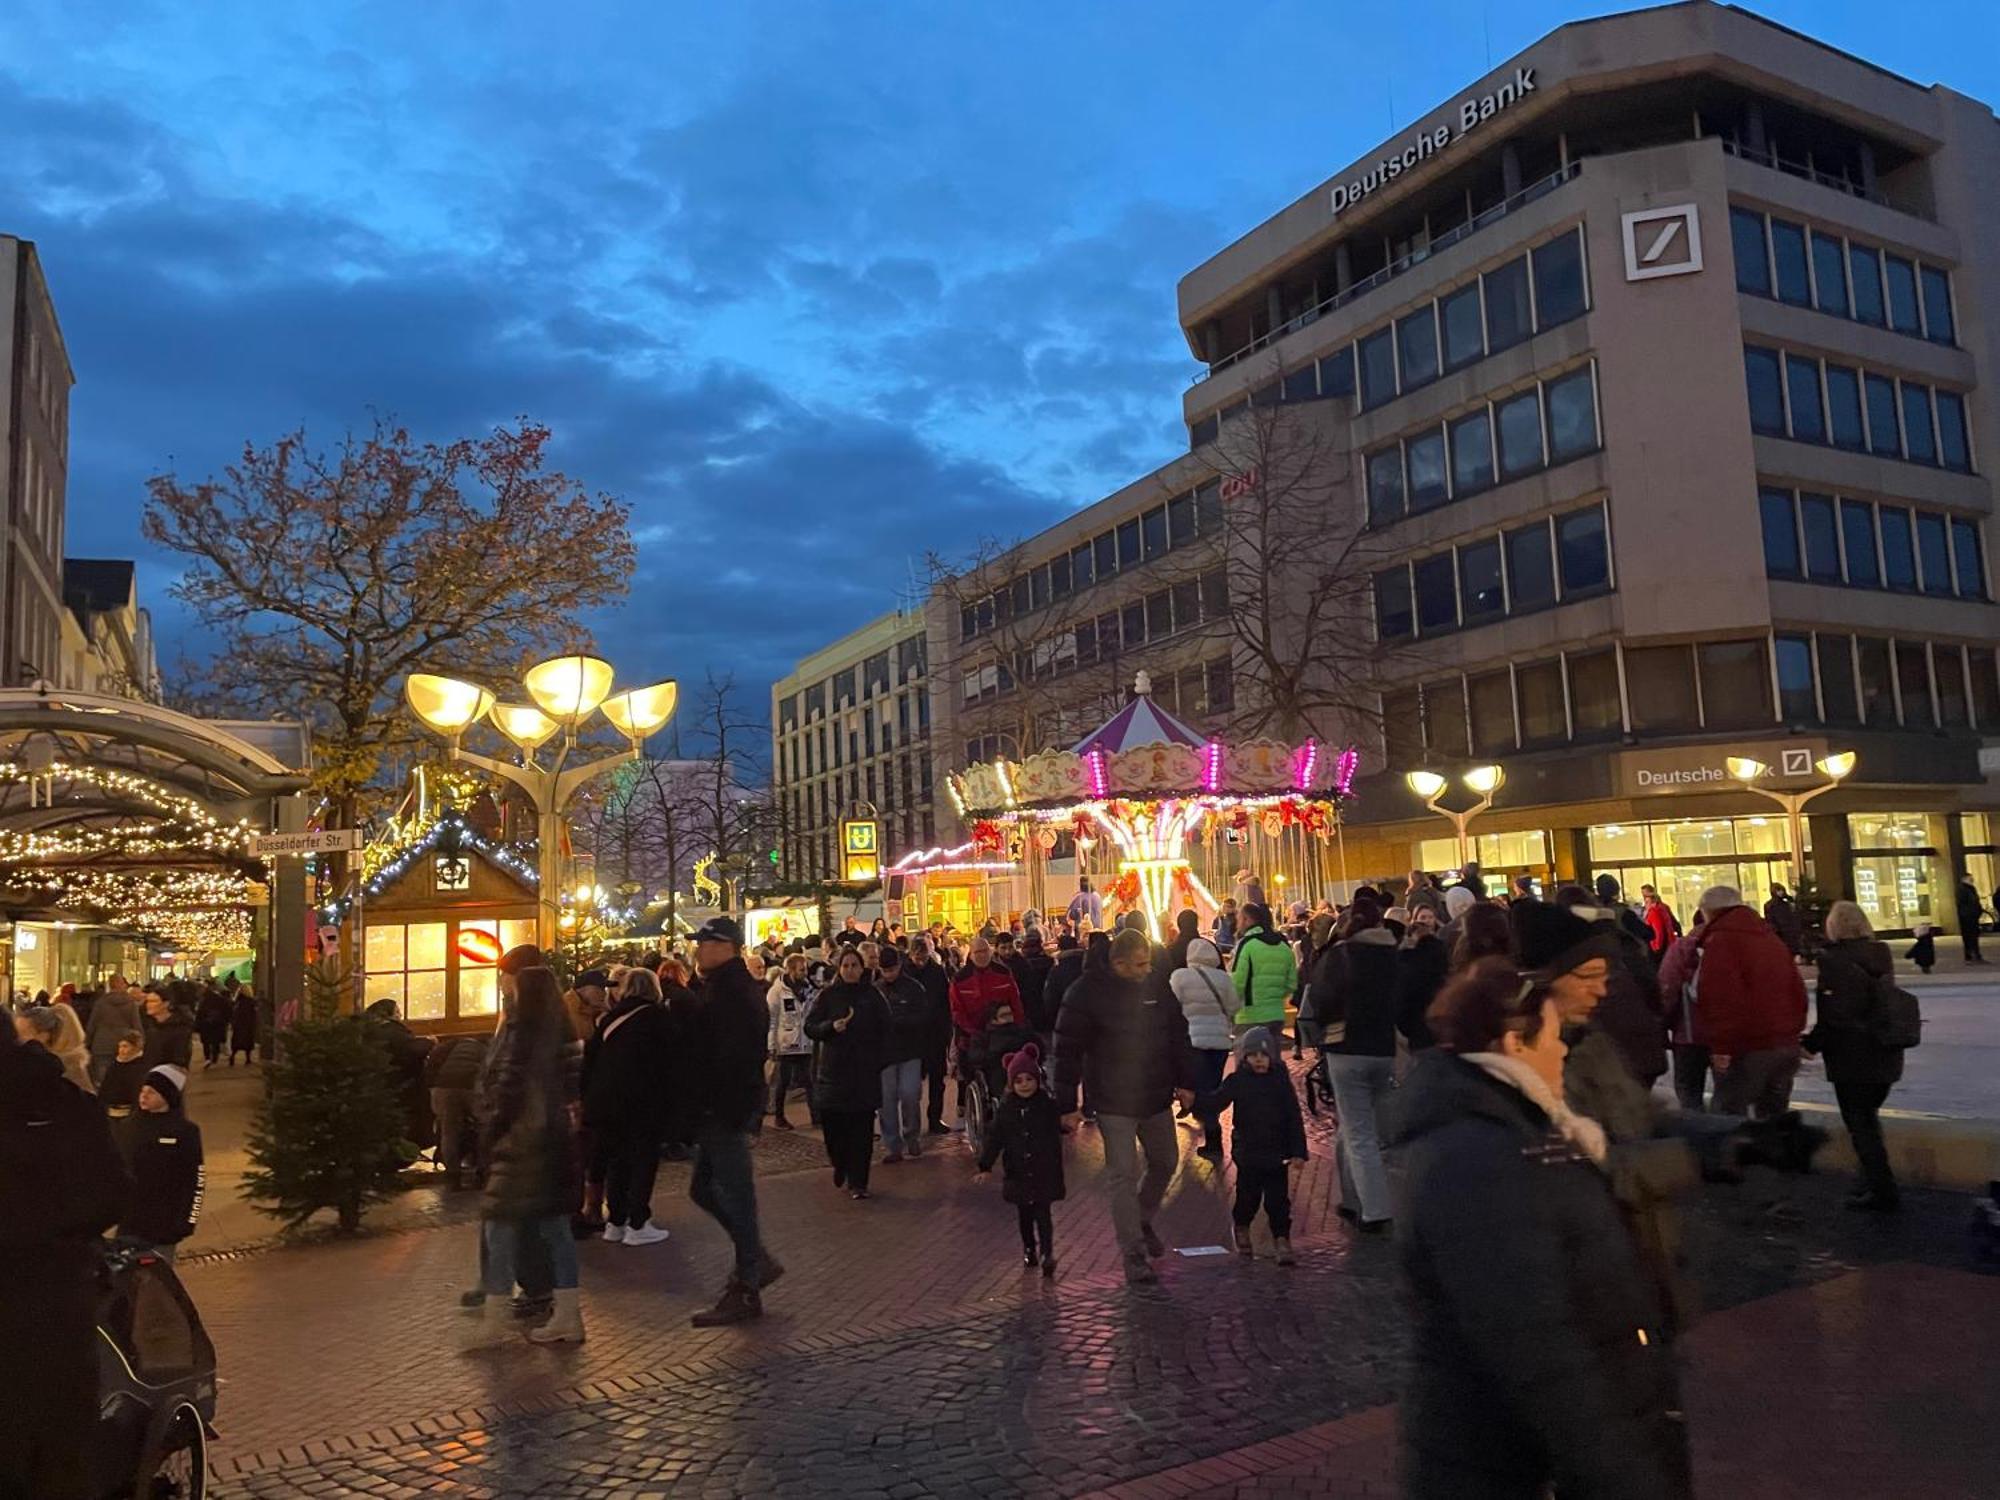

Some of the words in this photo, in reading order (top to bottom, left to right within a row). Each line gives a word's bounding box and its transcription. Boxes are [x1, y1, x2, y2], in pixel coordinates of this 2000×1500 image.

[1330, 124, 1450, 214] Deutsche
[1459, 67, 1535, 132] Bank
[1637, 766, 1724, 786] Deutsche
[256, 836, 320, 851] Düsseldorfer
[326, 834, 344, 847] Str.
